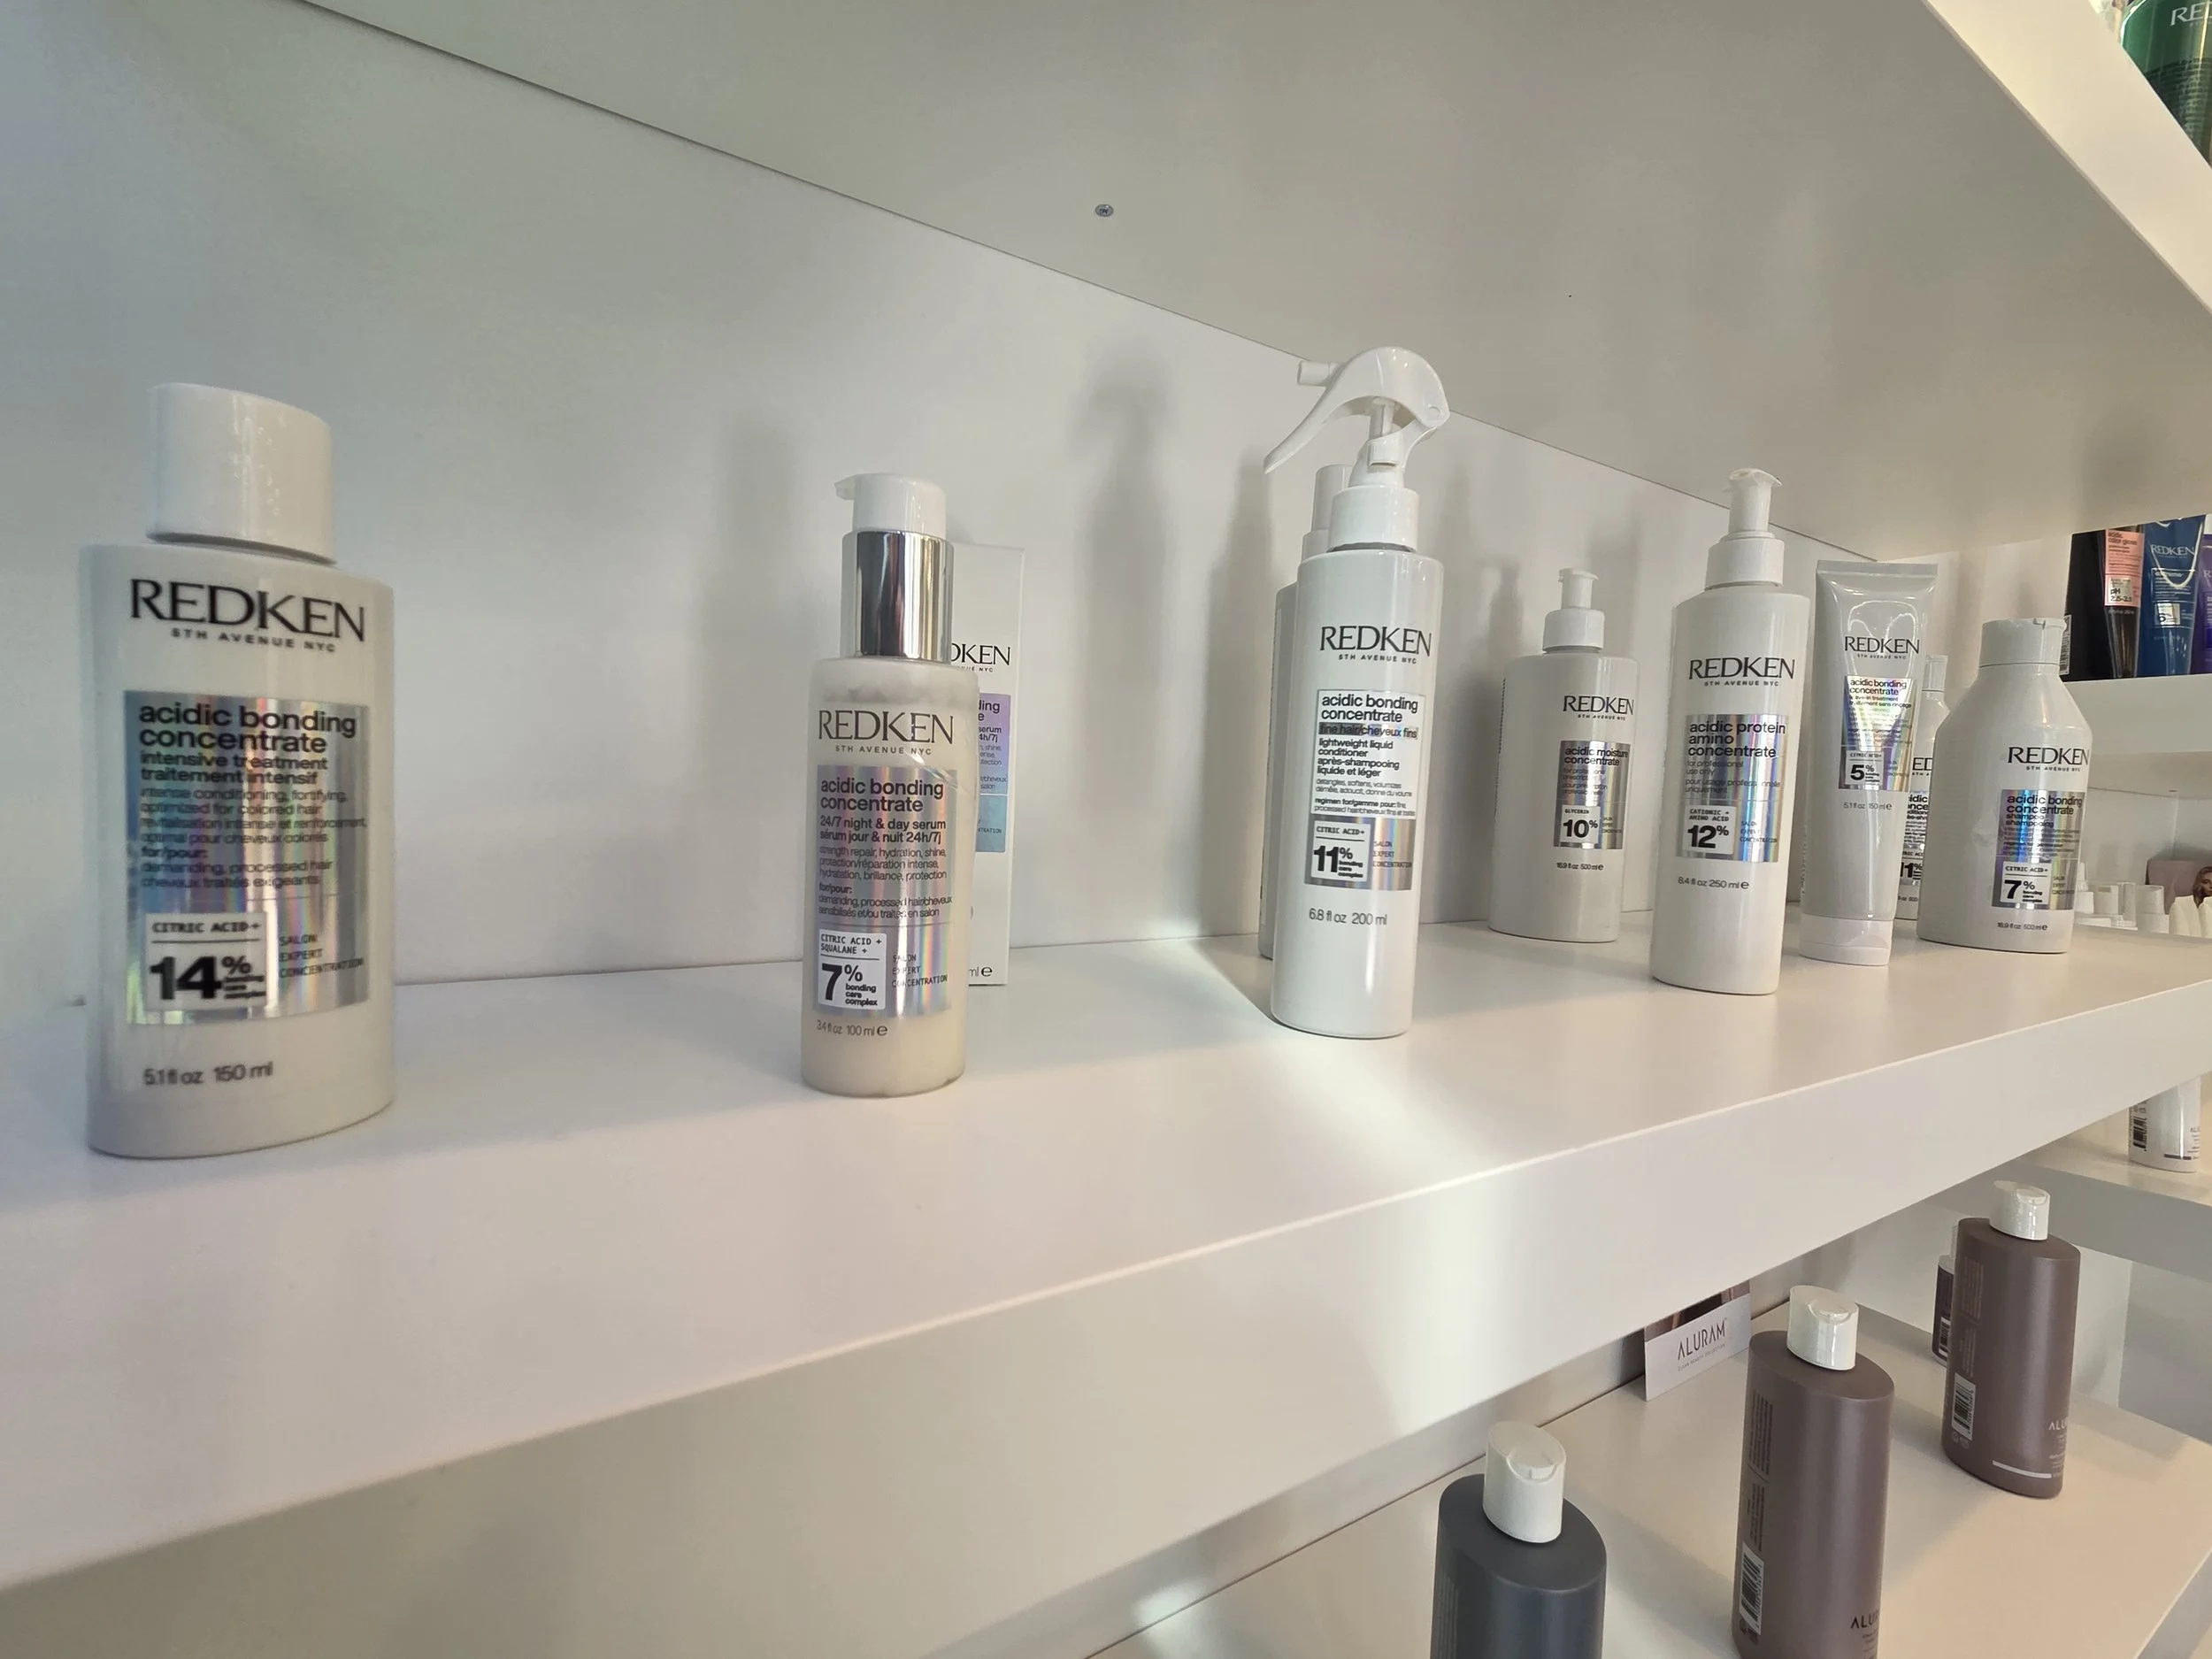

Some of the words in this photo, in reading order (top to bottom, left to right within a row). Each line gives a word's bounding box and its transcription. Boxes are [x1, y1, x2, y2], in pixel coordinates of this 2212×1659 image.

[2151, 544, 2195, 557] REDKEN
[130, 579, 365, 642] REDKEN
[172, 627, 208, 641] 5TH
[218, 631, 296, 649] AVENUE
[304, 641, 336, 654] NYC
[1320, 626, 1432, 657] REDKEN
[1845, 636, 1920, 656] REDKEN
[1361, 655, 1398, 664] AVENUE
[1689, 657, 1795, 680] REDKEN
[1849, 687, 1899, 695] concentrate
[1850, 679, 1873, 687] acidic
[1874, 680, 1908, 690] bonding
[1322, 694, 1363, 708] acidic
[1366, 695, 1418, 714] bonding
[1563, 695, 1635, 716] REDKEN
[139, 702, 232, 727] acidic
[239, 704, 357, 740] bonding
[1321, 710, 1403, 723] concentrate
[818, 710, 954, 745] REDKEN
[1320, 724, 1338, 734] fine
[1403, 727, 1418, 739] fins
[1689, 721, 1733, 733] acidic
[1736, 721, 1786, 737] protein
[139, 727, 327, 754] concentrate
[1318, 738, 1369, 749] lightweight
[1370, 740, 1394, 751] liquid
[1688, 733, 1734, 745] amino
[860, 745, 905, 756] AVENUE
[911, 747, 933, 757] NYC
[1318, 748, 1369, 758] conditioner
[1564, 747, 1596, 757] acidic
[1688, 746, 1777, 758] concentrate
[2008, 747, 2090, 765] REDKEN
[142, 750, 227, 767] intensive
[234, 753, 327, 770] treatment
[1317, 757, 1401, 771] après-shampooing
[1564, 757, 1620, 767] concentrate
[142, 768, 242, 783] traitement
[247, 770, 319, 786] intensif
[1317, 765, 1346, 777] liquide
[1347, 767, 1356, 777] et
[1358, 767, 1382, 779] léger
[1850, 764, 1875, 781] 5%
[821, 777, 866, 795] acidic
[871, 779, 944, 800] bonding
[821, 795, 924, 813] concentrate
[2007, 795, 2047, 805] acidic
[2048, 795, 2083, 809] bonding
[213, 803, 235, 816] for
[241, 803, 295, 816] colored
[297, 803, 322, 816] hair
[2007, 805, 2074, 816] concentrate
[820, 815, 842, 828] 24/7
[844, 818, 873, 832] night
[876, 818, 885, 829] &
[888, 818, 910, 833] day
[913, 820, 947, 831] serum
[1317, 826, 1340, 835] CITRIC
[1563, 818, 1599, 839] 10%
[190, 833, 221, 847] pour
[226, 832, 284, 845] cheveux
[820, 829, 848, 841] sérum
[848, 831, 869, 844] jour
[872, 832, 881, 841] &
[883, 831, 904, 842] nuit
[1687, 825, 1730, 849] 12%
[851, 847, 878, 861] repair,
[879, 847, 924, 862] hydration,
[925, 847, 947, 857] shine,
[1313, 845, 1354, 873] 11%
[230, 861, 308, 874] processed
[311, 860, 334, 872] hair
[908, 859, 941, 871] intense,
[1709, 879, 1727, 889] 250
[2004, 879, 2036, 900] 7%
[919, 908, 941, 918] salon
[1333, 913, 1347, 925] oz
[1352, 913, 1373, 926] 200
[1376, 914, 1388, 926] ml
[151, 922, 204, 934] CITRIC
[821, 933, 847, 945] CITRIC
[850, 936, 872, 947] ACID
[821, 943, 857, 955] SQUALANE
[150, 955, 253, 1001] 14%
[822, 963, 864, 1002] 7%
[846, 983, 878, 994] bonding
[845, 999, 879, 1008] complex
[833, 1025, 843, 1035] oz
[847, 1025, 863, 1037] 100
[864, 1025, 876, 1037] ml
[182, 1070, 204, 1085] oz
[214, 1064, 246, 1082] 150
[250, 1062, 274, 1079] ml
